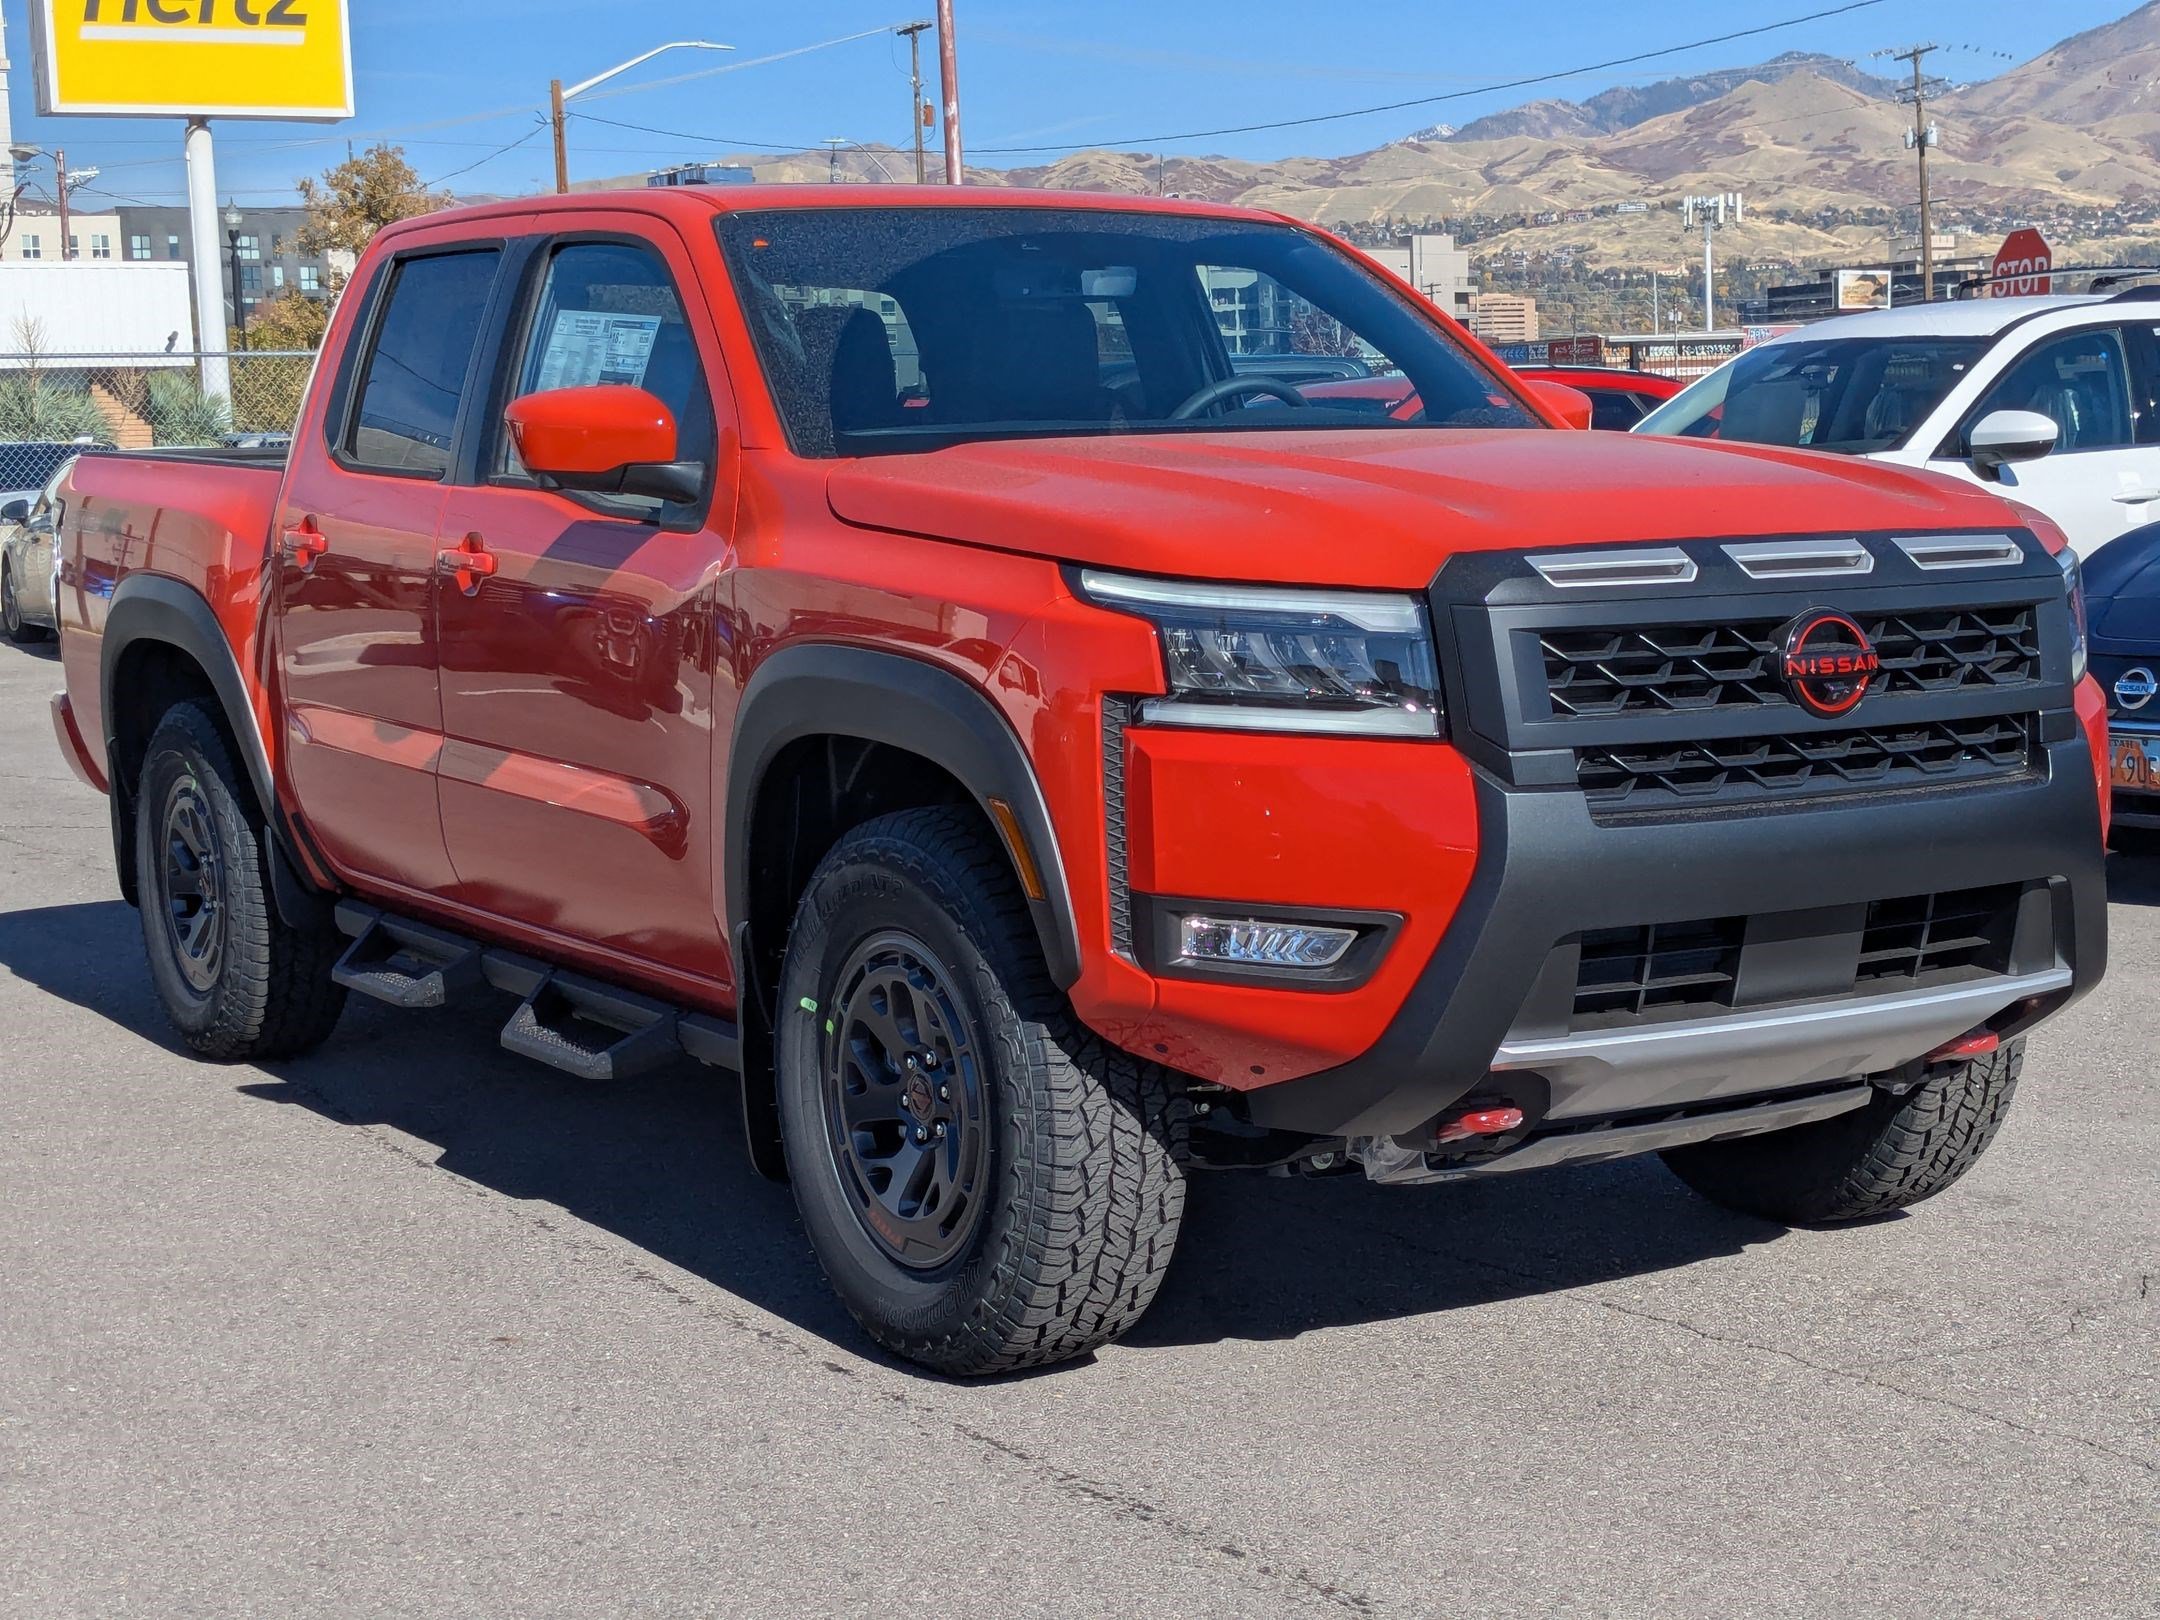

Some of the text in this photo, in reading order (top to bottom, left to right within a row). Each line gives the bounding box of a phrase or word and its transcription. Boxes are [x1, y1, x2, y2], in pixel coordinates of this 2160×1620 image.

[1995, 256, 2048, 297] STOP
[1787, 654, 1879, 676] NISSAN
[2117, 684, 2149, 693] NISSAN
